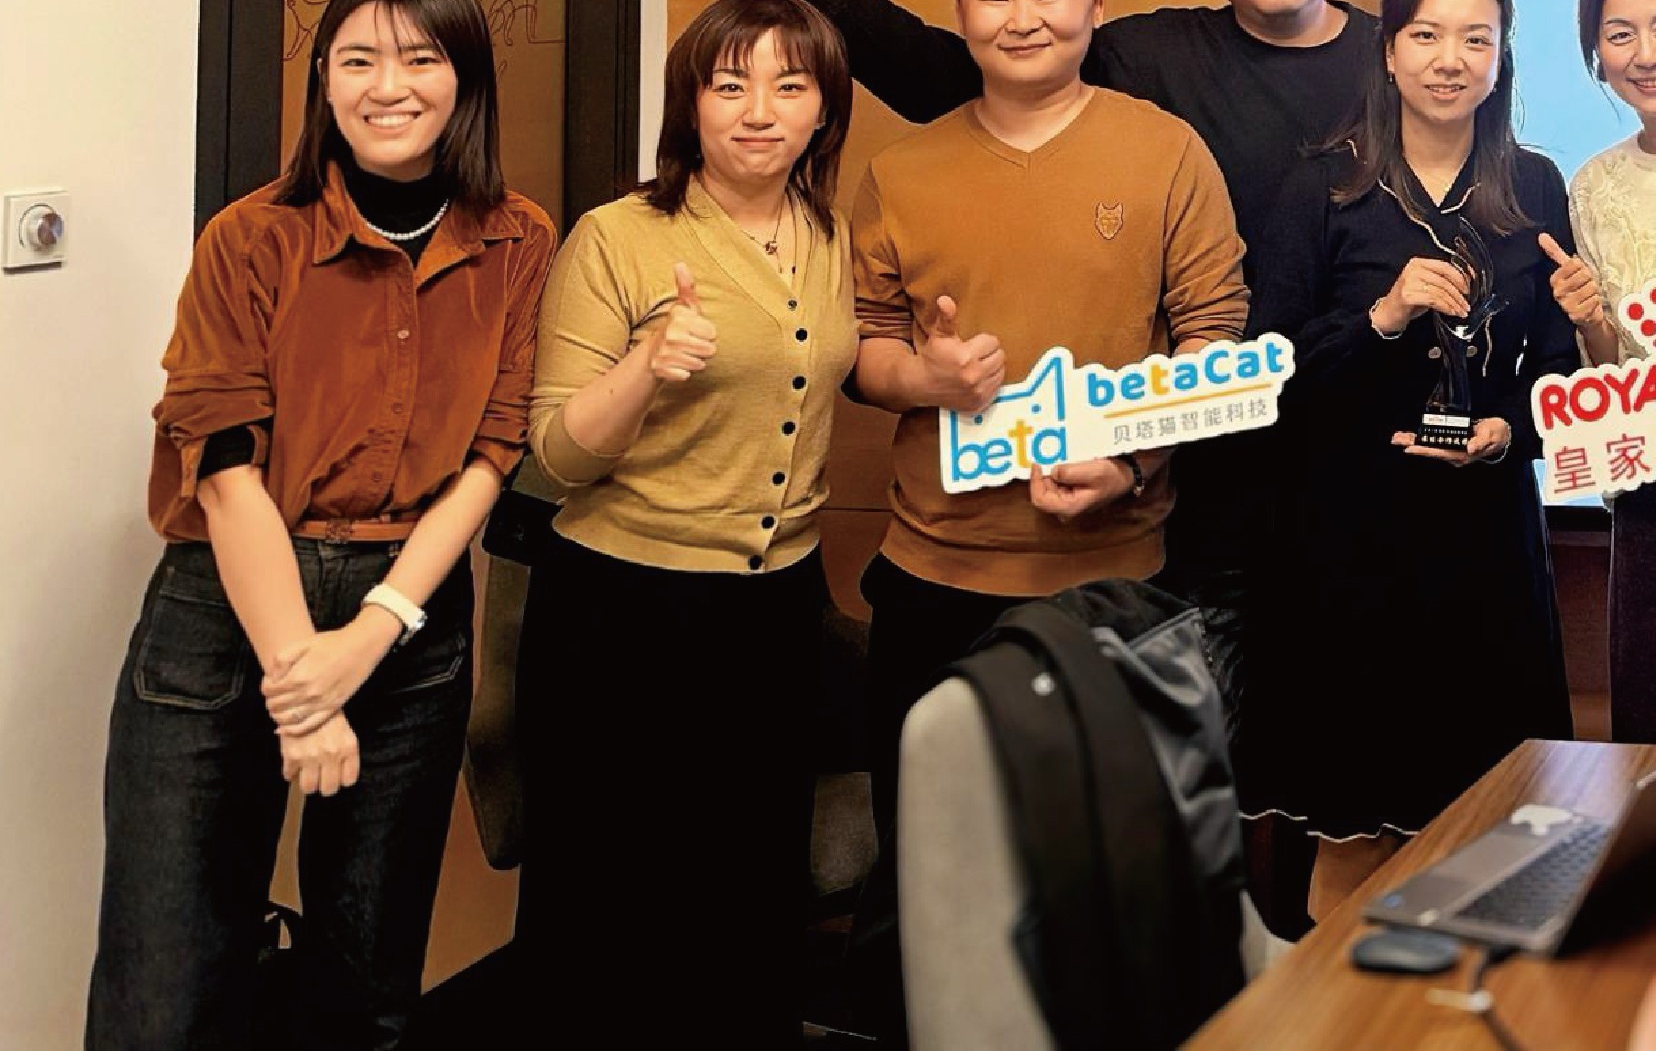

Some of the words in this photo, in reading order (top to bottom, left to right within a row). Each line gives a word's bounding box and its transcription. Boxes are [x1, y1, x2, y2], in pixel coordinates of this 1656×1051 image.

[1088, 342, 1284, 407] betaCat
[951, 420, 1067, 482] beta
[1113, 398, 1268, 445] 贝塔猫智能科技
